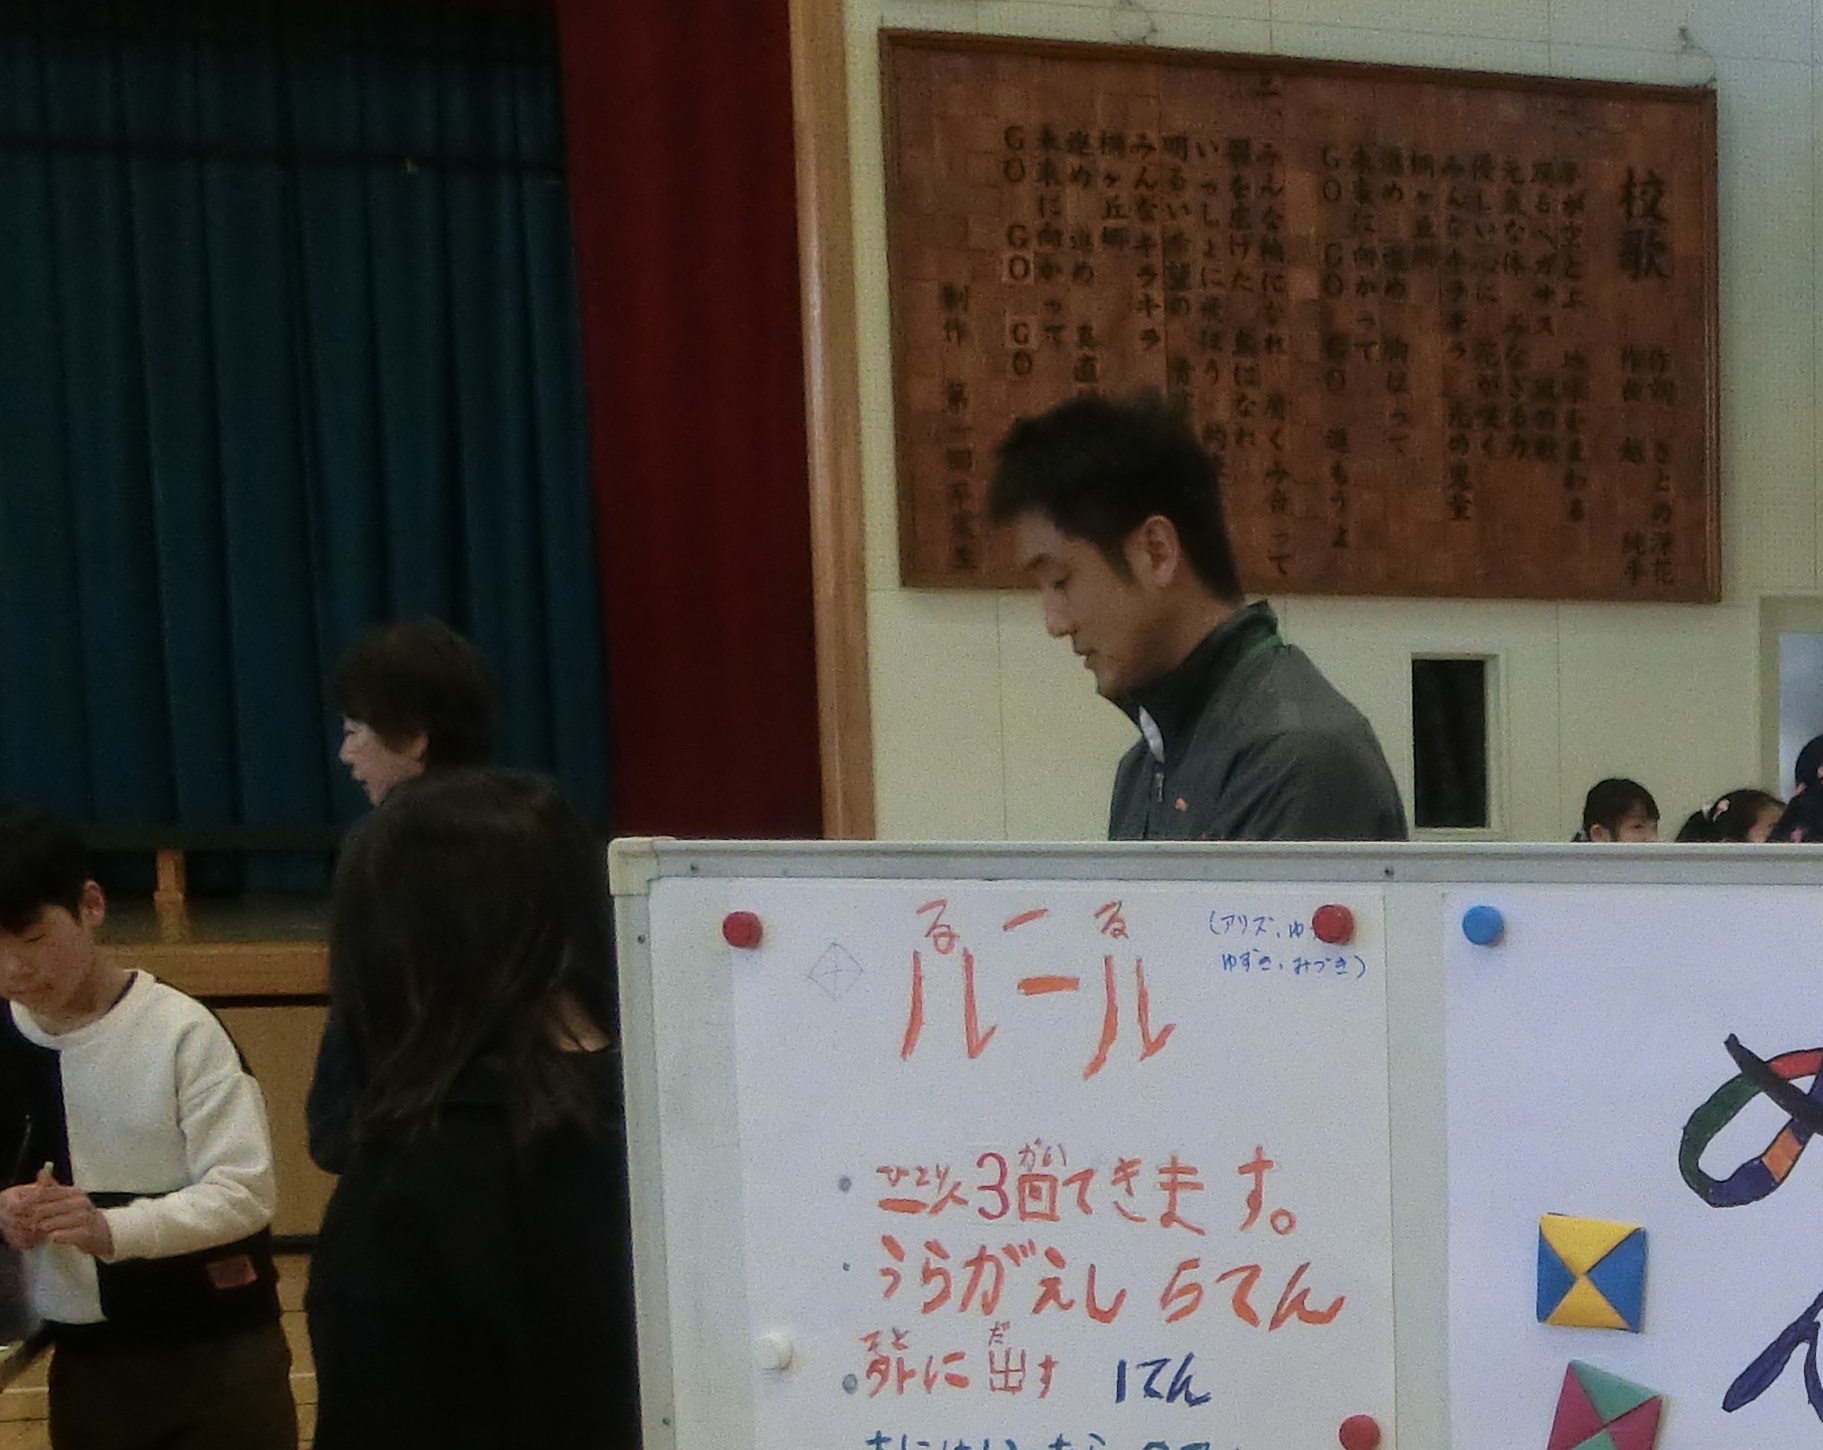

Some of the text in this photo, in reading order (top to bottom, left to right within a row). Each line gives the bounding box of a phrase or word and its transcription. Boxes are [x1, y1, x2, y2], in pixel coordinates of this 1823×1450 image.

[1003, 125, 1033, 377] GO GO GO
[1619, 165, 1673, 281] 校歌
[900, 948, 1176, 1080] ルール
[879, 1235, 1127, 1323] うらがえし
[1114, 1351, 1212, 1407] 1てん
